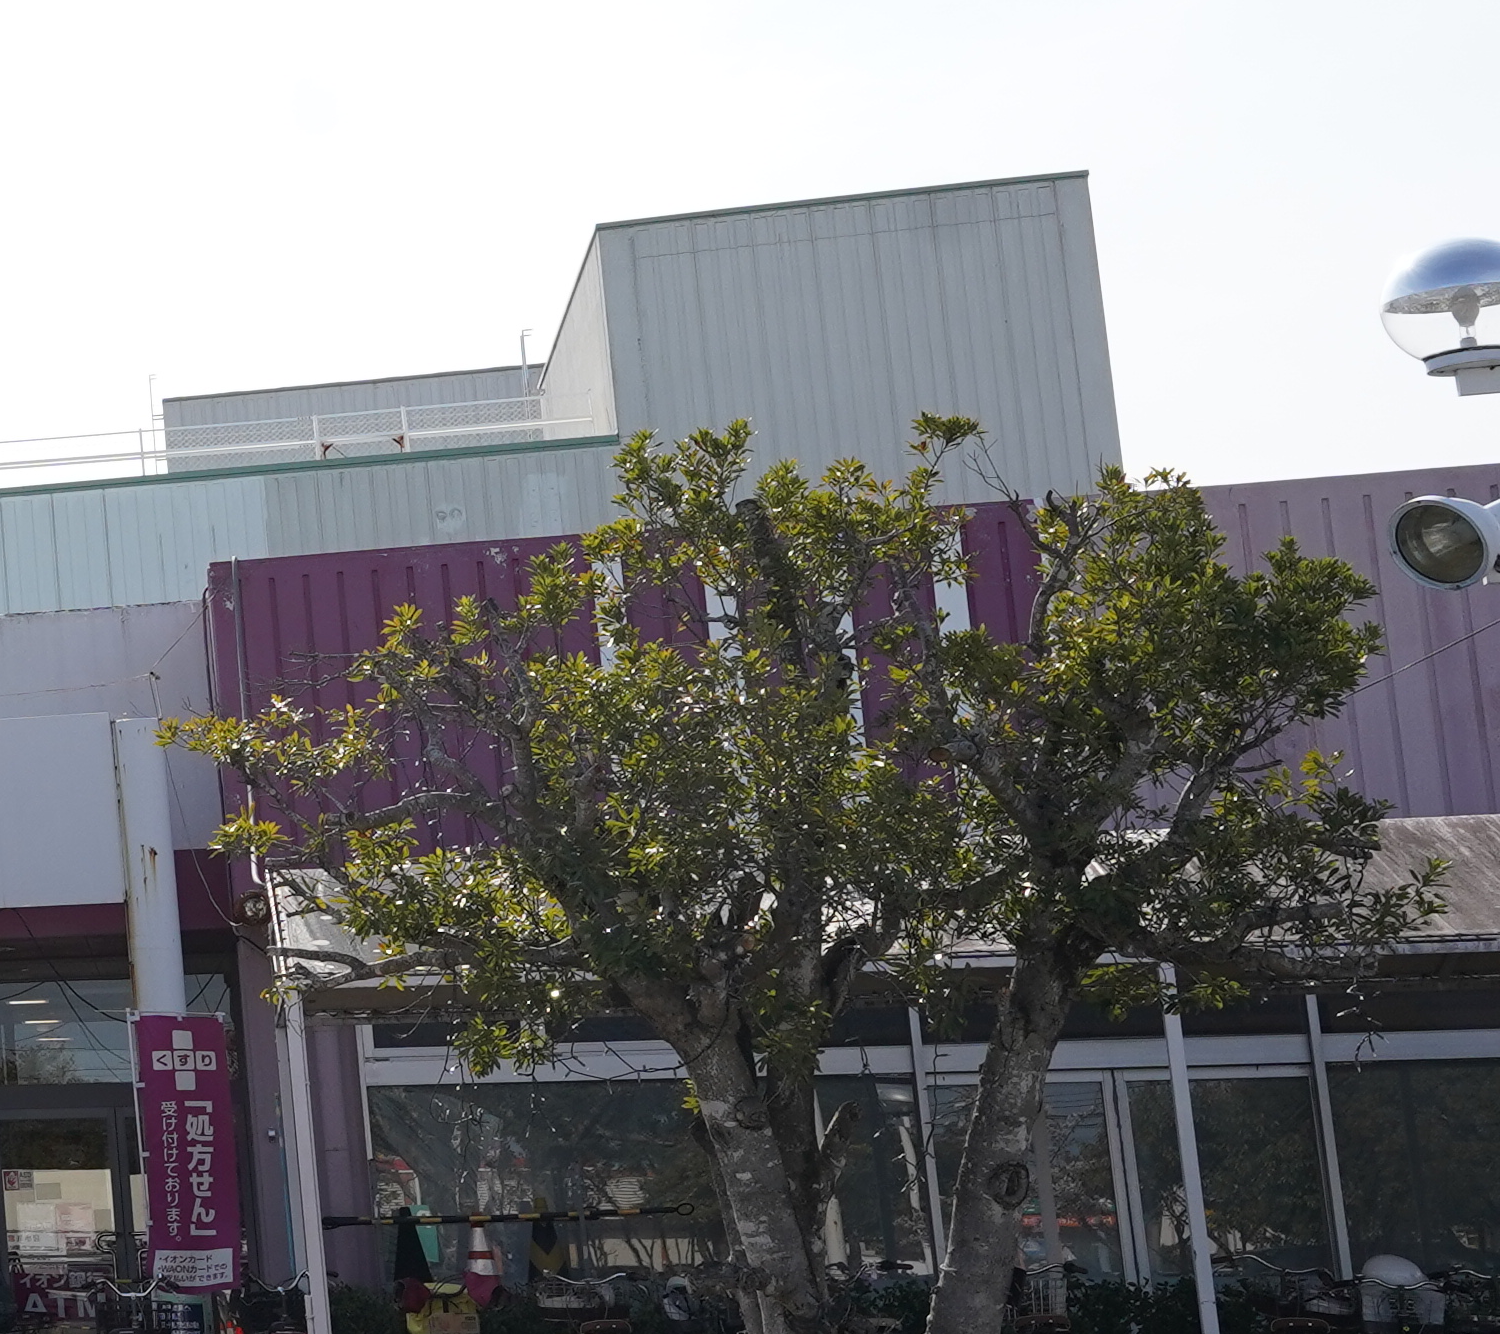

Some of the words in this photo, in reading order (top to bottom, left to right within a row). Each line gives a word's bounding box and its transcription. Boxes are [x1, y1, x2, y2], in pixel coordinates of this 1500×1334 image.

[155, 1053, 212, 1067] くすり
[160, 1100, 182, 1242] 受け付けております。
[184, 1100, 217, 1236] 「処方せん」
[23, 1289, 107, 1318] ATM
